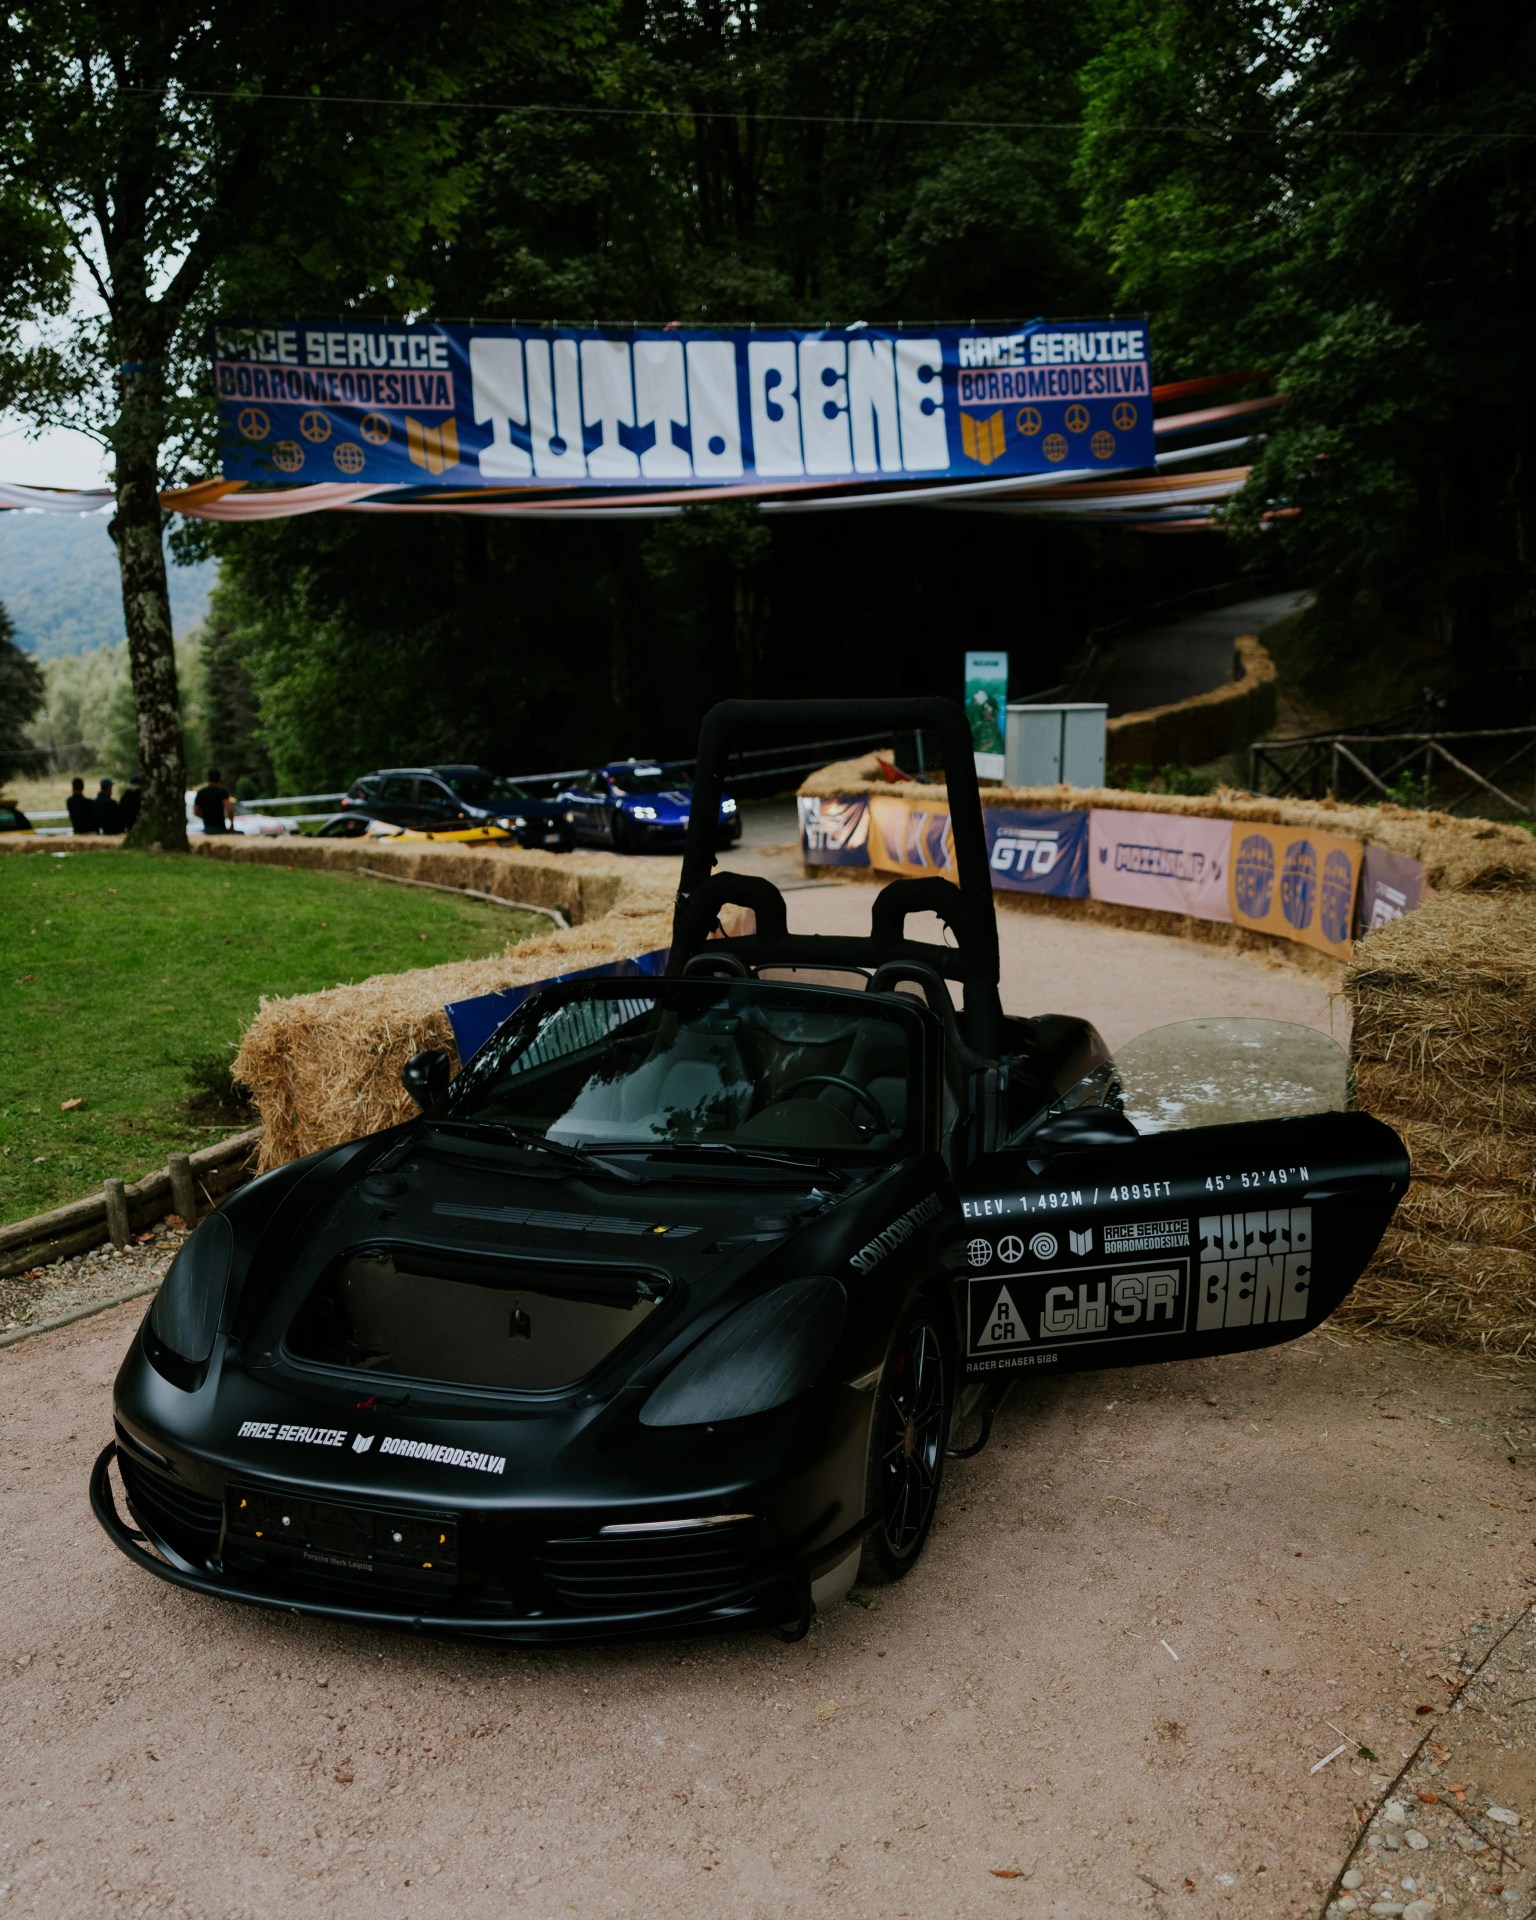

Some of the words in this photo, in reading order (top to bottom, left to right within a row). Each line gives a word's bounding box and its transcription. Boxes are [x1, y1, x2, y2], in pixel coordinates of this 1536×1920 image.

[215, 326, 299, 364] CE
[305, 331, 449, 369] SERVICE
[958, 334, 1026, 368] RACE
[1030, 330, 1145, 365] SERVICE
[219, 365, 450, 405] BORROMEODESILVA
[961, 365, 1145, 401] BORROMEODESILVA
[469, 337, 744, 479] TUTTO
[747, 338, 950, 477] BENE
[990, 837, 1059, 875] GTO
[962, 1198, 1011, 1218] ELEV.
[1020, 1190, 1083, 1213] 1,492M
[1093, 1187, 1099, 1205] /
[1109, 1181, 1172, 1202] 4895FT
[1205, 1174, 1231, 1192] 45°
[878, 1214, 917, 1250] DOWN
[1104, 1234, 1190, 1254] BORROMEODESILVA
[1105, 1225, 1135, 1240] RACE
[1136, 1220, 1188, 1237] SERVICE
[1198, 1206, 1313, 1263] TUTTO
[1195, 1251, 1312, 1331] BENE
[997, 1302, 1009, 1320] R
[991, 1322, 1015, 1341] CR
[966, 1361, 997, 1372] RACER
[998, 1355, 1035, 1368] CHASER
[237, 1421, 280, 1439] RACE
[275, 1424, 348, 1447] SERVICE
[379, 1436, 507, 1475] BORROMEODESILVA
